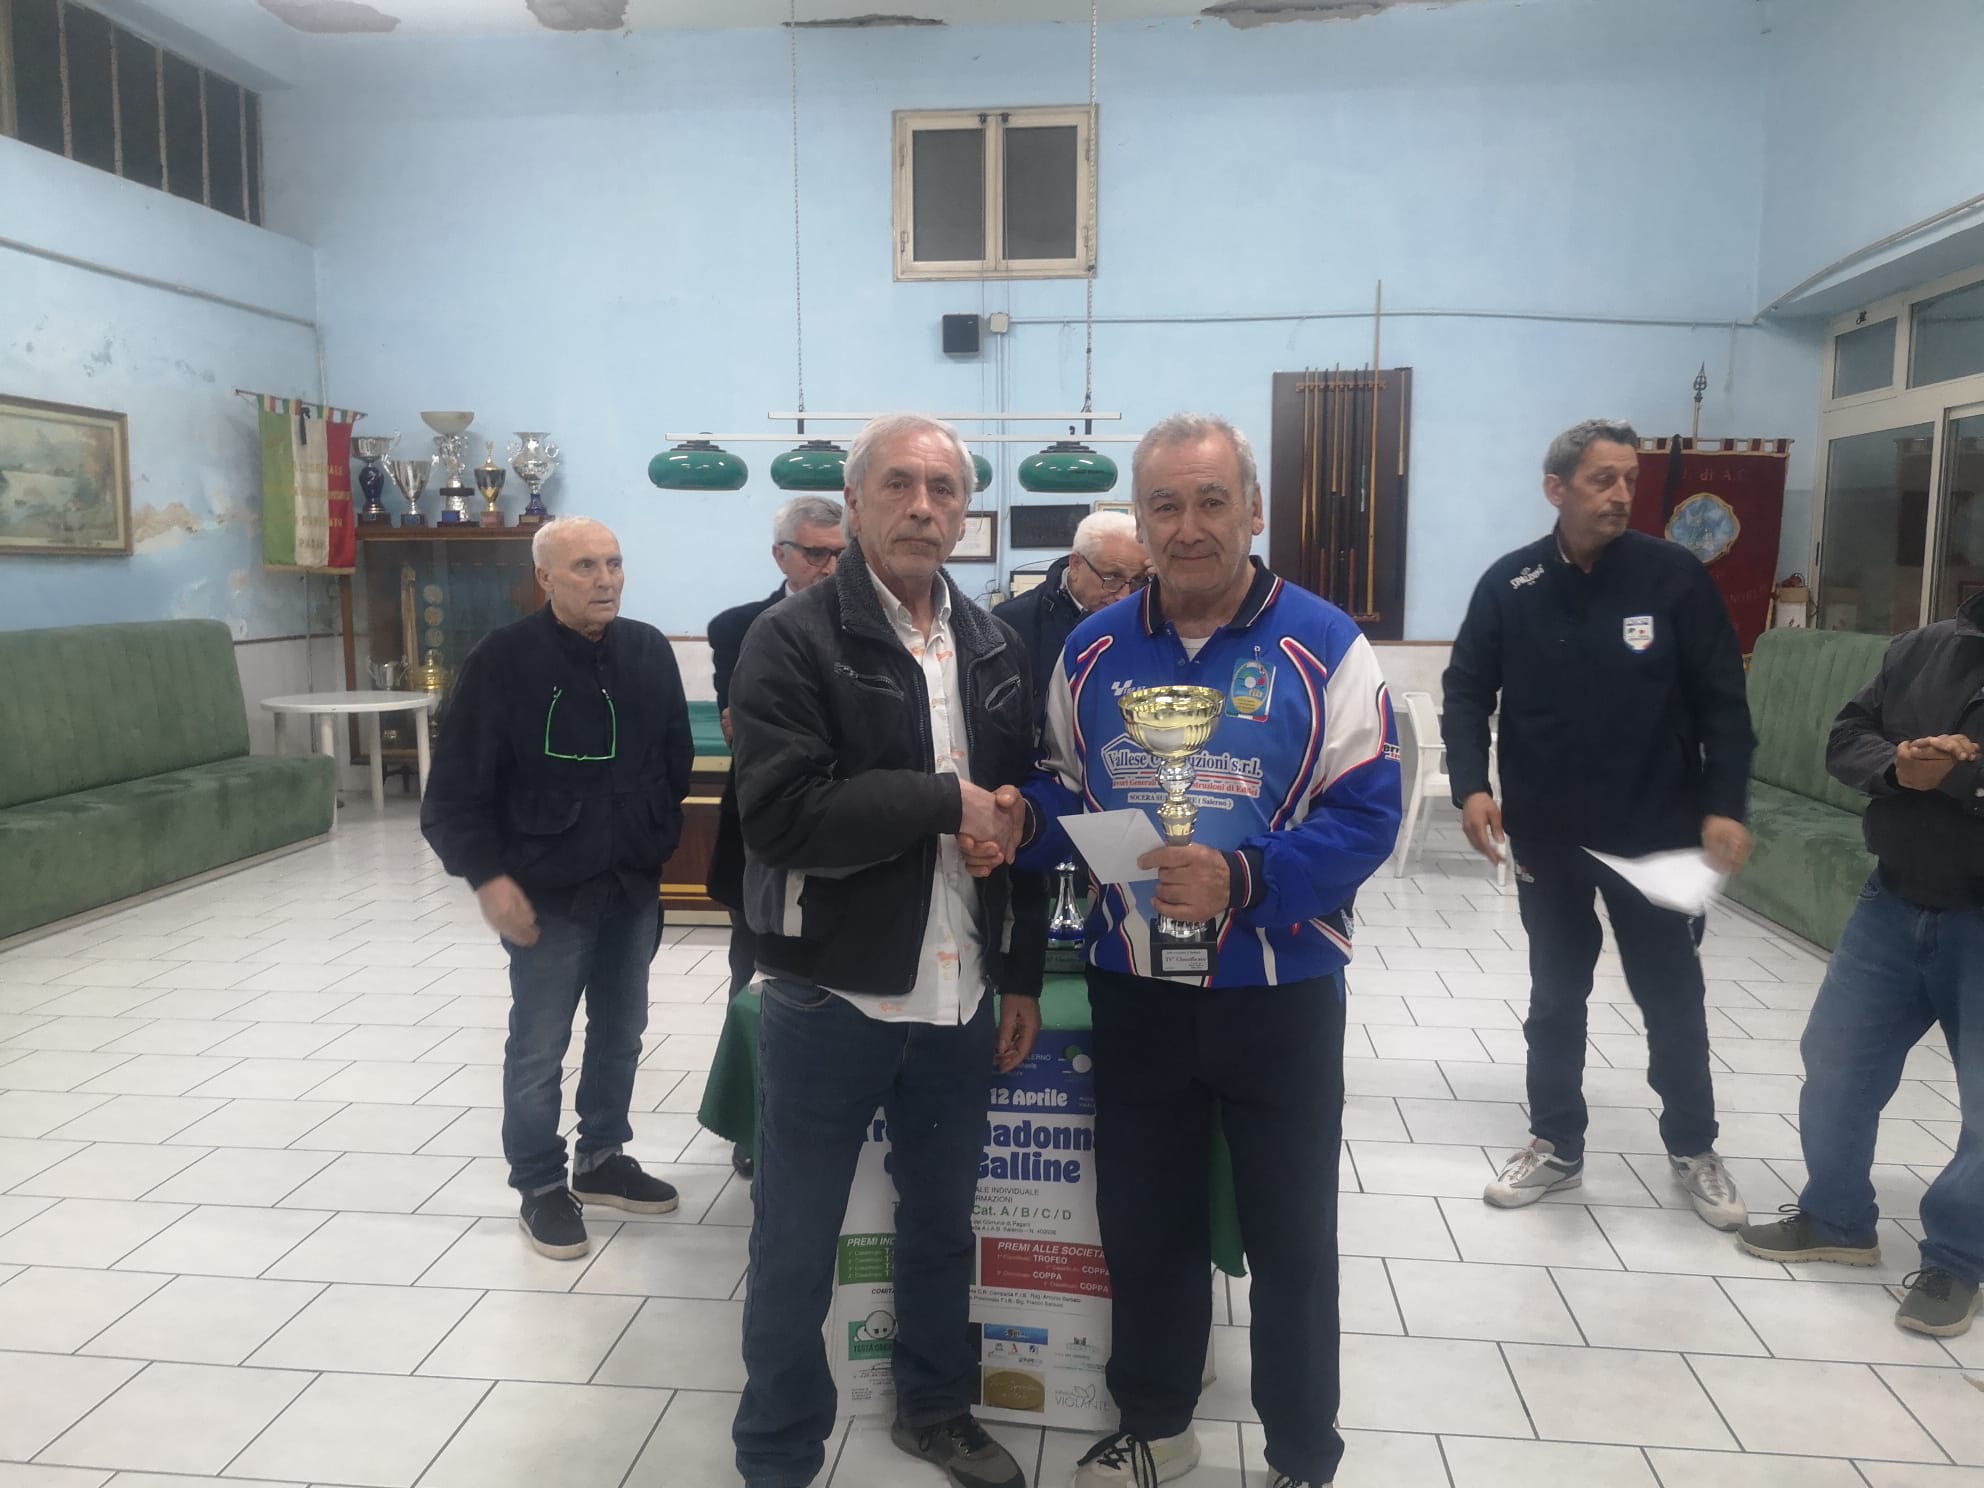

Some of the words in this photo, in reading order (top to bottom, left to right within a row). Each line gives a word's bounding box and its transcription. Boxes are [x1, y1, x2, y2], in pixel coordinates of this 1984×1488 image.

[1108, 751, 1147, 769] Vallese
[1231, 760, 1261, 777] s.r.l.
[1012, 1087, 1068, 1107] Aprile
[984, 1119, 1095, 1151] adonn
[991, 1186, 1039, 1197] INDIVIDUALE
[1000, 1205, 1010, 1217] A
[1021, 1207, 1031, 1218] B
[1041, 1208, 1051, 1219] C
[1062, 1209, 1072, 1221] D
[847, 1237, 878, 1247] PREMI
[997, 1241, 1030, 1252] PREMI
[1031, 1243, 1059, 1254] ALLE
[1033, 1254, 1068, 1265] TROFEO
[1032, 1271, 1063, 1281] COPPA
[1079, 1281, 1109, 1293] COPPA
